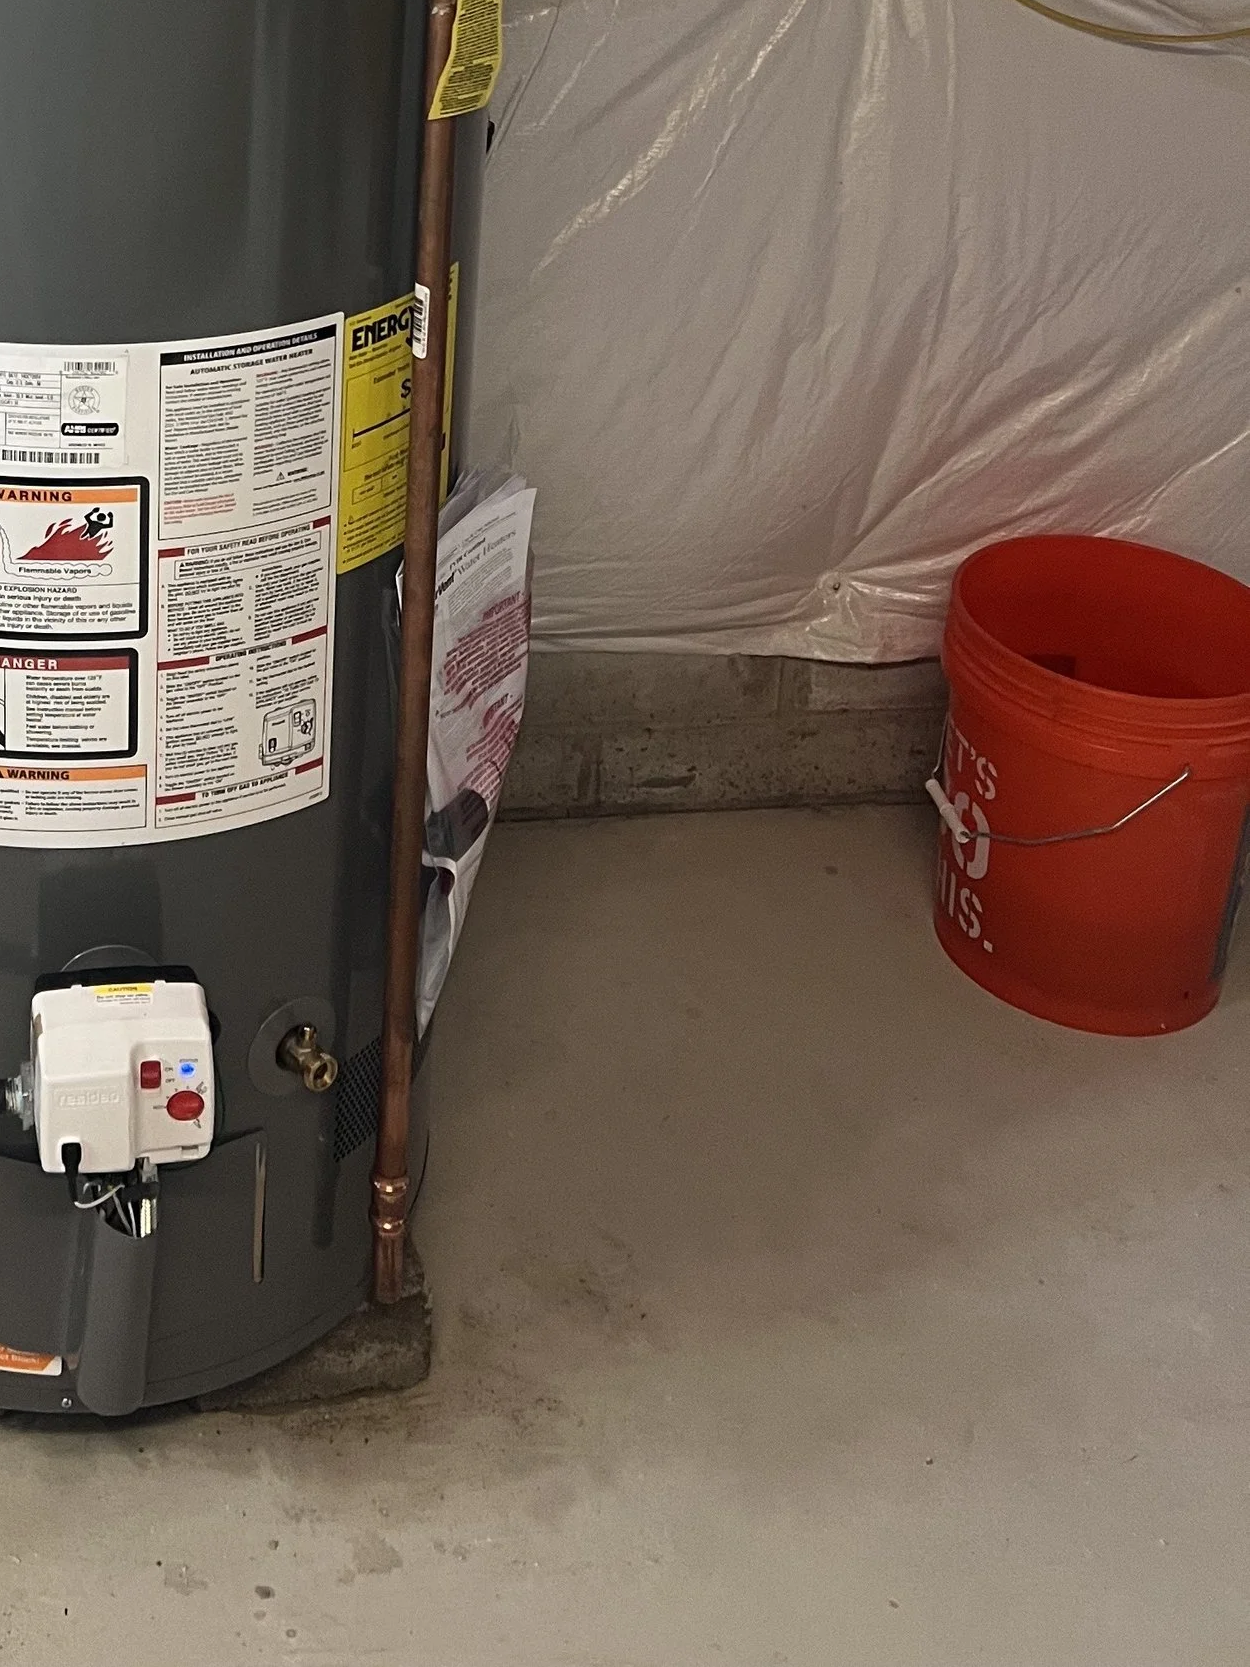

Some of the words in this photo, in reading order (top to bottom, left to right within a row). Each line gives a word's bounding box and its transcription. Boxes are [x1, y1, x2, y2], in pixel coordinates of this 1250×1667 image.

[183, 349, 235, 362] INSTALLATION
[237, 346, 251, 355] AND
[253, 339, 291, 353] OPERATION
[292, 333, 318, 344] DETAILS
[190, 364, 231, 375] AUTOMATIC
[233, 359, 264, 370] STORAGE
[265, 354, 287, 364] WATER
[289, 348, 313, 359] HEATER
[201, 545, 217, 553] YOUR
[219, 541, 241, 550] SAFETY
[19, 566, 61, 574] Flammable
[4, 585, 45, 593] EXPLOSION
[7, 769, 69, 781] WARNING
